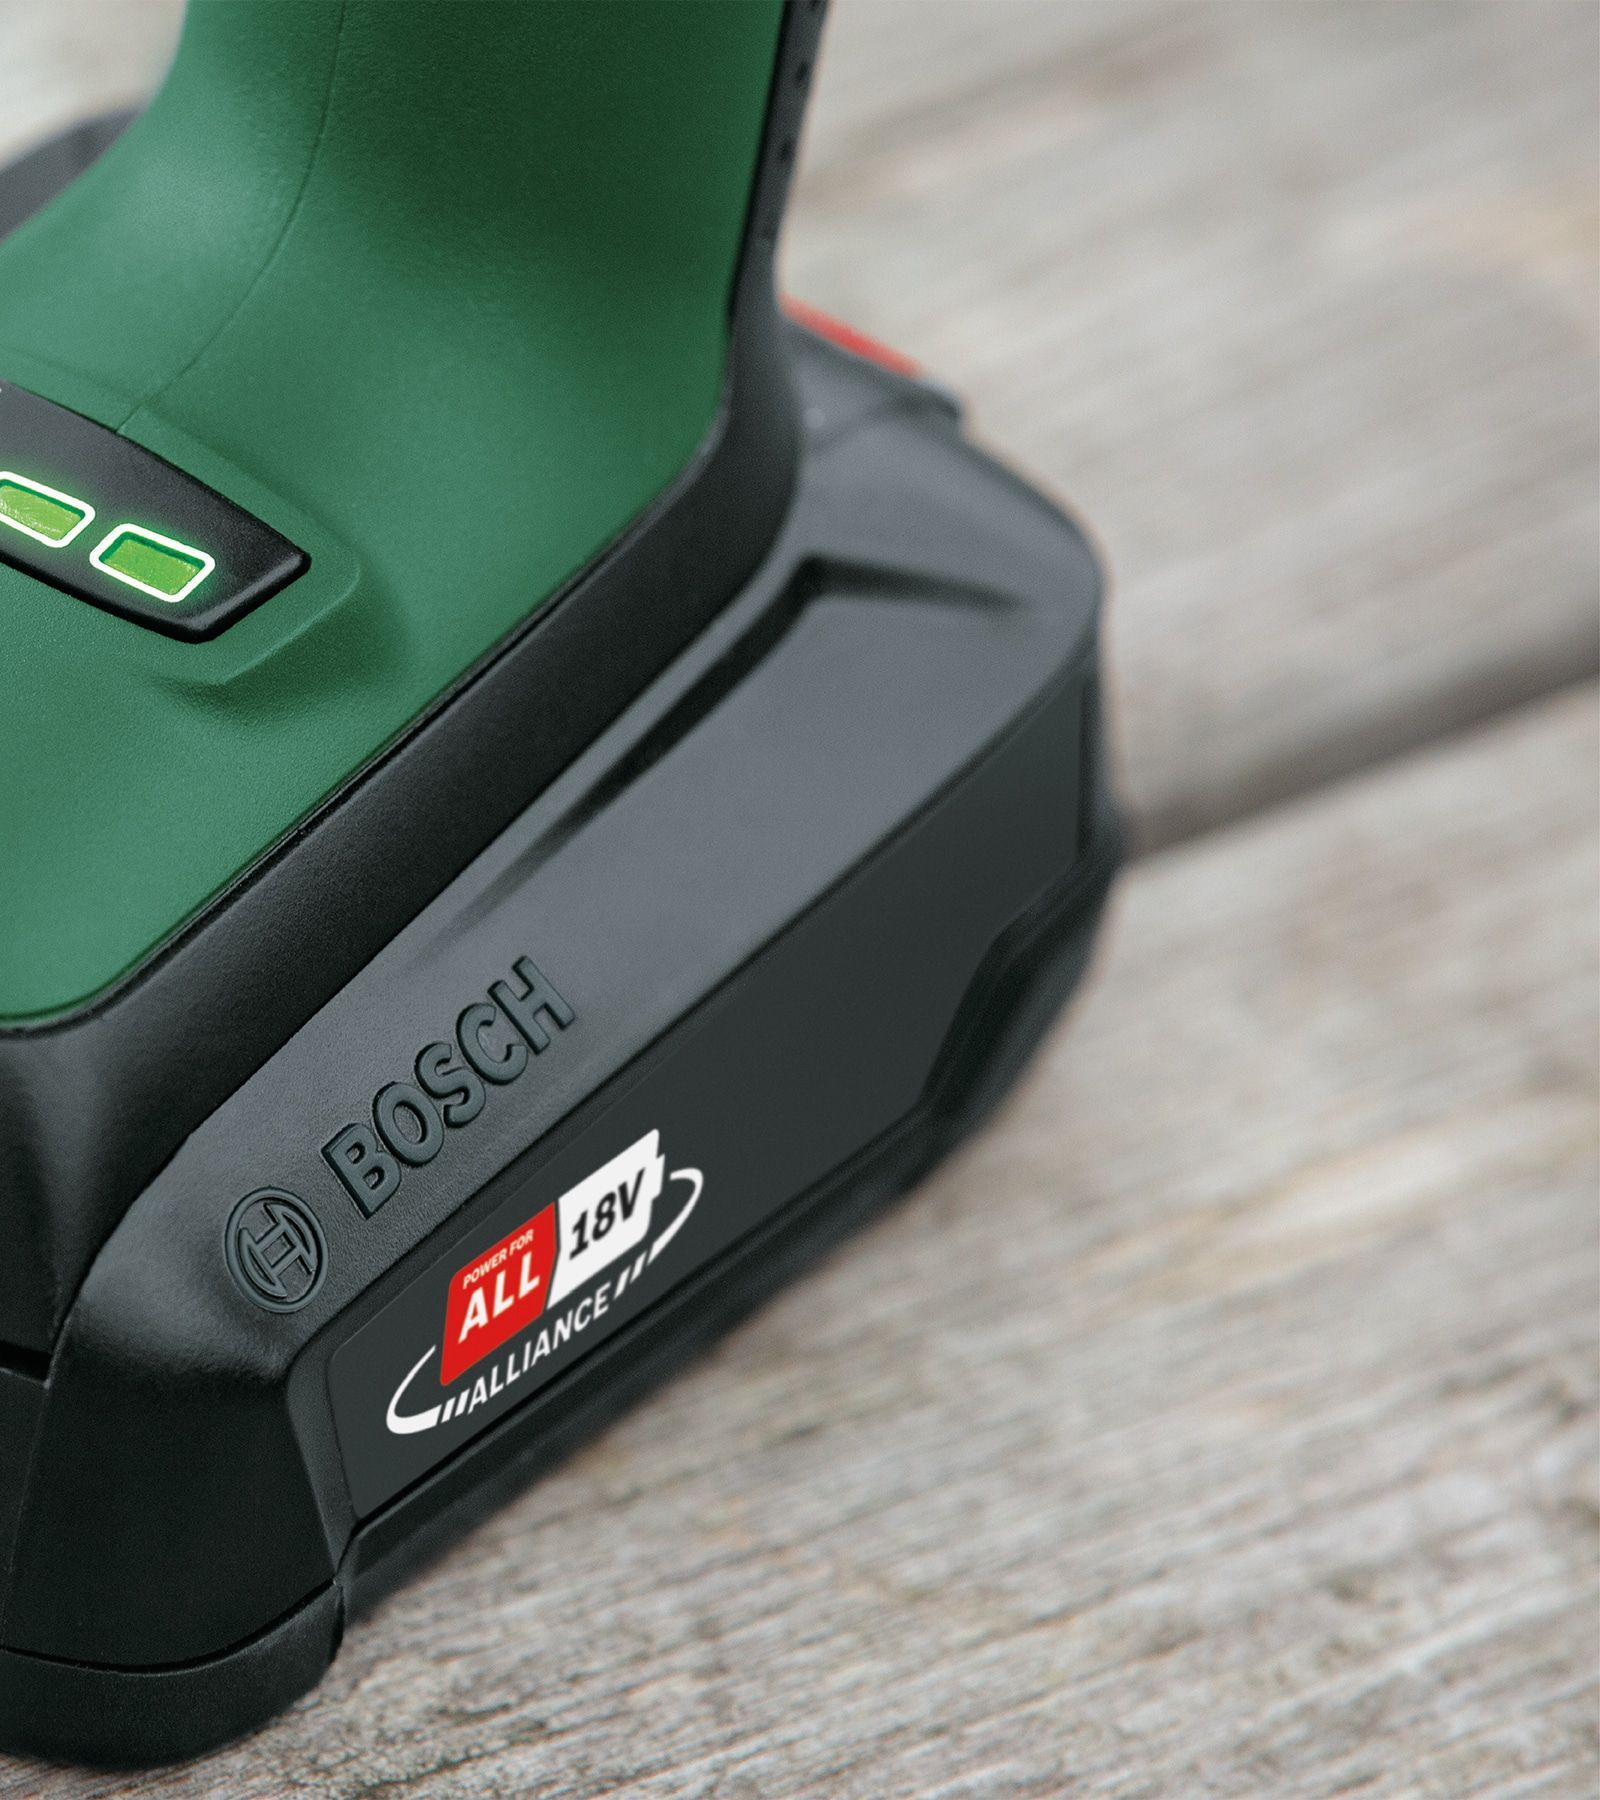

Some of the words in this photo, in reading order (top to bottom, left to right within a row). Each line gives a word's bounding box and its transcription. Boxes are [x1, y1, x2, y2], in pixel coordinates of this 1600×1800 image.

[321, 955, 575, 1218] BOSCH
[462, 1248, 508, 1290] POWER
[509, 1229, 534, 1256] FOR
[569, 1167, 646, 1260] 18V
[457, 1251, 541, 1344] ALL
[467, 1282, 611, 1415] ALLIANCE
